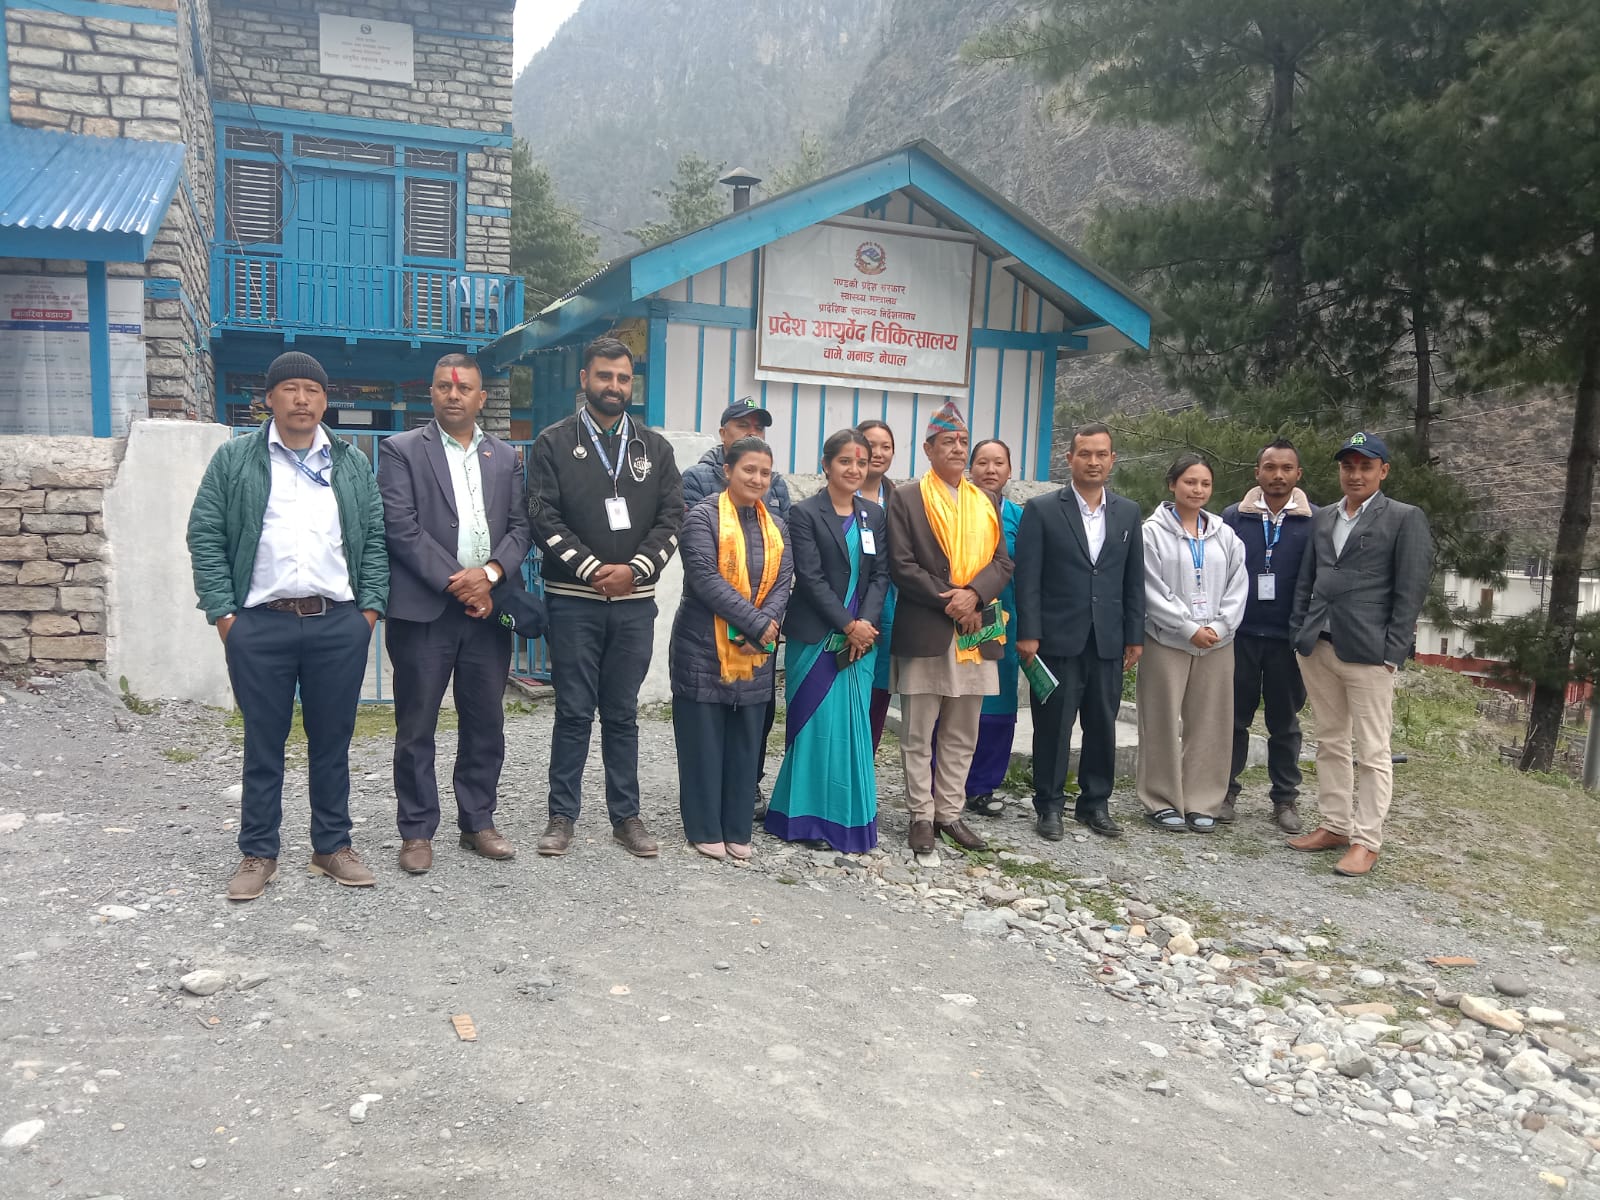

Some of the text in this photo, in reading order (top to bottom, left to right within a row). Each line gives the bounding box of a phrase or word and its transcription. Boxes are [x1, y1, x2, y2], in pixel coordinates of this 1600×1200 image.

[861, 281, 878, 292] प्रदेश
[881, 284, 906, 295] सरकार
[840, 292, 866, 302] स्वास्थ्य
[818, 302, 847, 314] प्रादेशिक
[851, 307, 877, 316] स्वास्थ्य
[768, 312, 959, 351] प्रदेश आयुर्वेद चिकित्सालय
[879, 350, 908, 366] नेपाल
